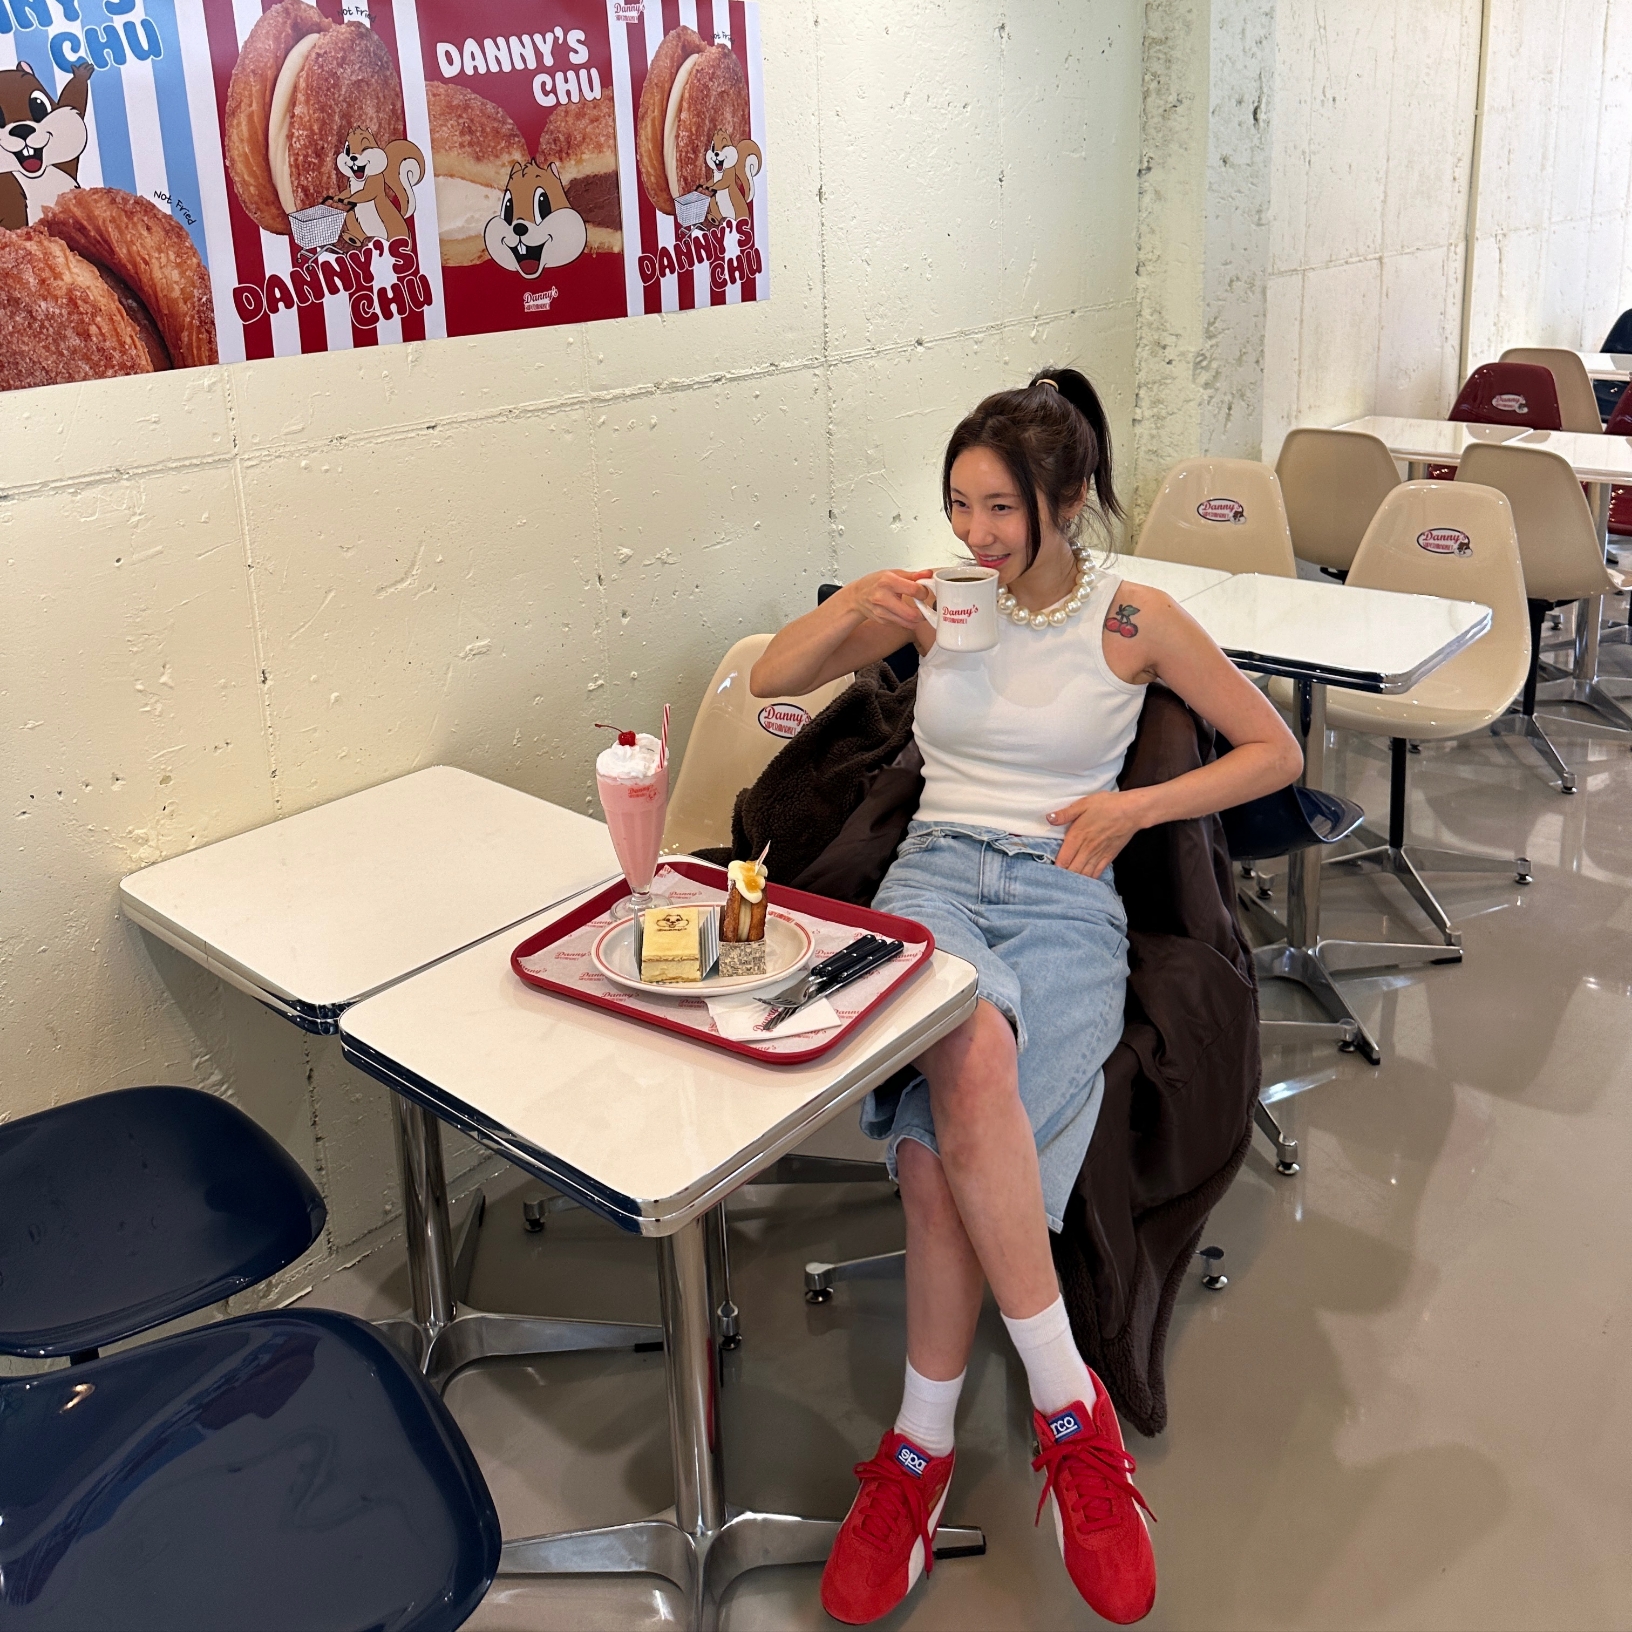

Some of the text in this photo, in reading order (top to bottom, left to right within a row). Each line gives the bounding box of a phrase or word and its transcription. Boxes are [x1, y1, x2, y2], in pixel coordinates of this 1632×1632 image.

[49, 17, 163, 74] CHU
[436, 25, 590, 79] DANNY'S
[532, 67, 602, 107] CHU
[153, 190, 197, 225] Not Fried
[638, 217, 753, 286] DANNY'S
[710, 247, 763, 291] CHU
[232, 236, 416, 325] DANNY'S
[523, 286, 559, 304] Danny's
[350, 273, 433, 329] CHU
[1201, 501, 1240, 513] Danny's
[1422, 531, 1467, 544] Danny's
[942, 604, 979, 617] Danny's
[763, 705, 812, 726] Danny's
